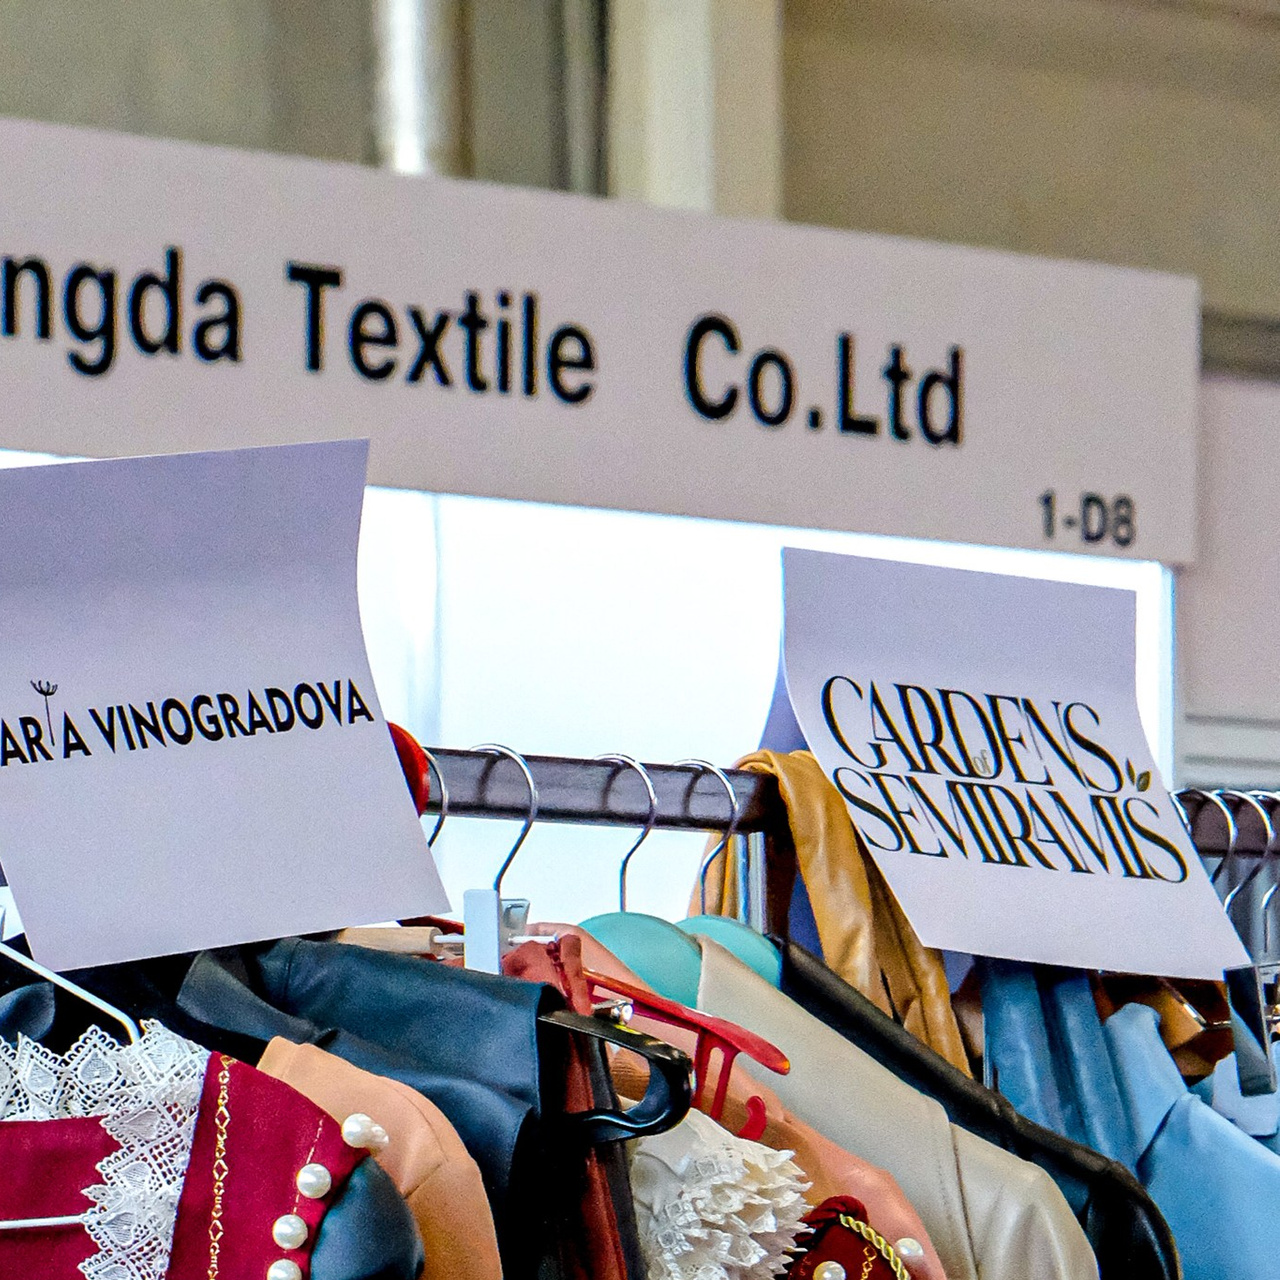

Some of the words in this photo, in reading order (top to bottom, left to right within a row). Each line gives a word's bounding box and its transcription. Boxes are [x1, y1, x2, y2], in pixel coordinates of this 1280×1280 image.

[284, 260, 597, 406] Textile
[682, 312, 964, 449] Co.Ltd
[1038, 490, 1136, 549] 1-D8
[89, 678, 375, 754] VINOGRADOVA
[821, 674, 1123, 794] GARDENS
[832, 766, 1189, 884] SEMIRAMIS
